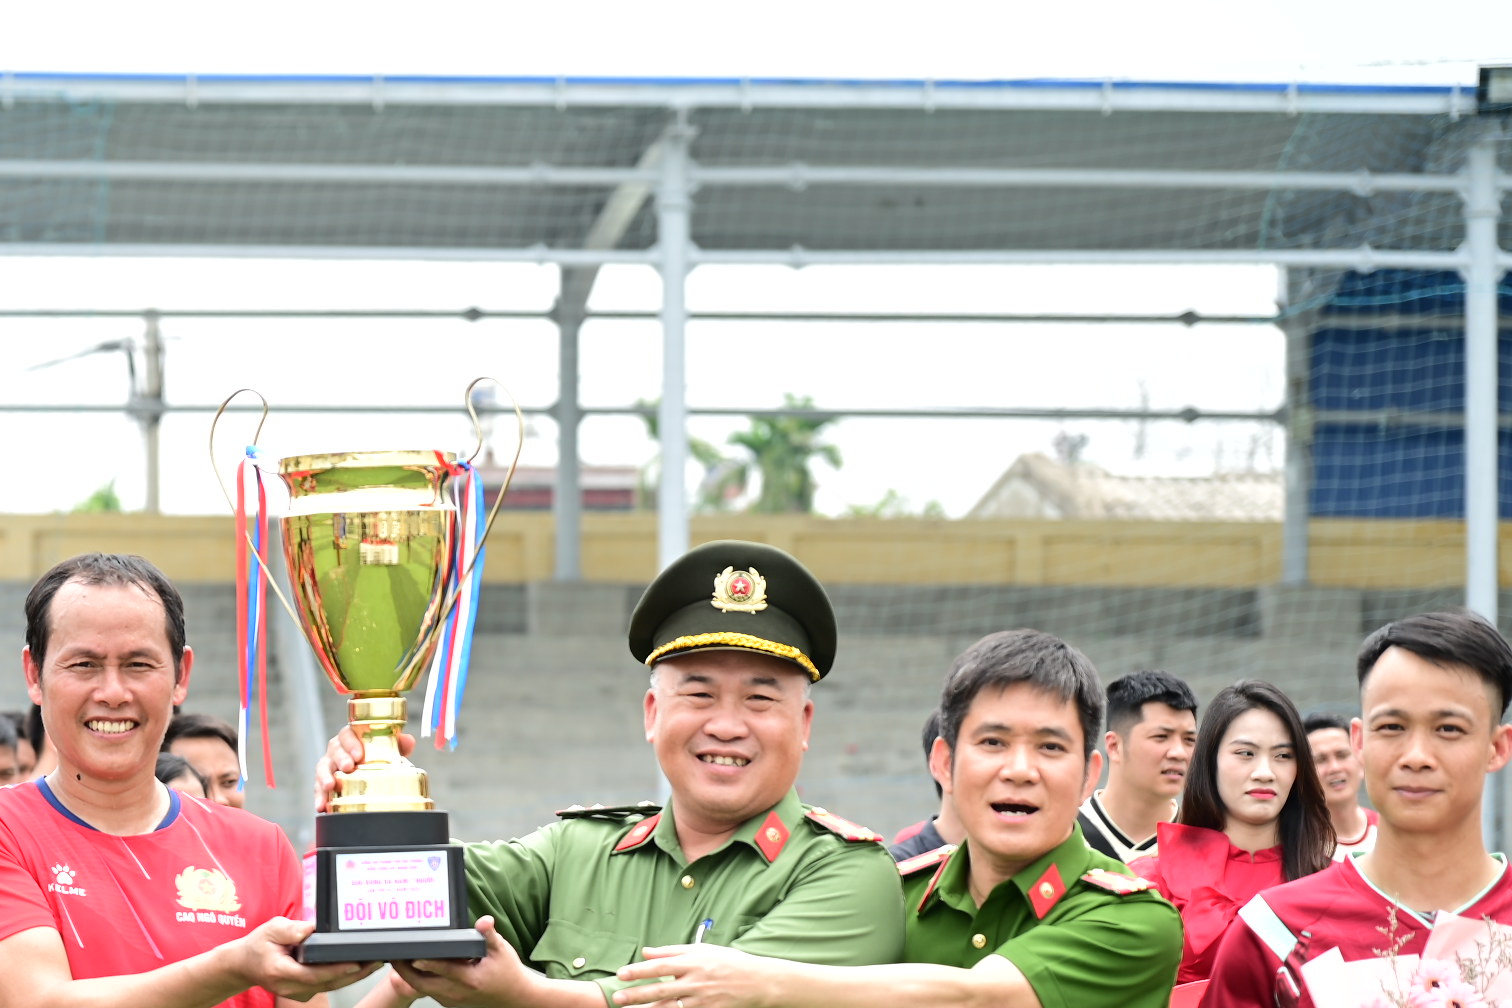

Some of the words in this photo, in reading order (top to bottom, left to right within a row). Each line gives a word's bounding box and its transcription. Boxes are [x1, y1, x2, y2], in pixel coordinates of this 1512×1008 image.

[48, 883, 87, 897] KELME
[344, 898, 372, 926] ĐỘI
[378, 897, 398, 920] VÔ
[405, 900, 444, 923] ĐỊCH
